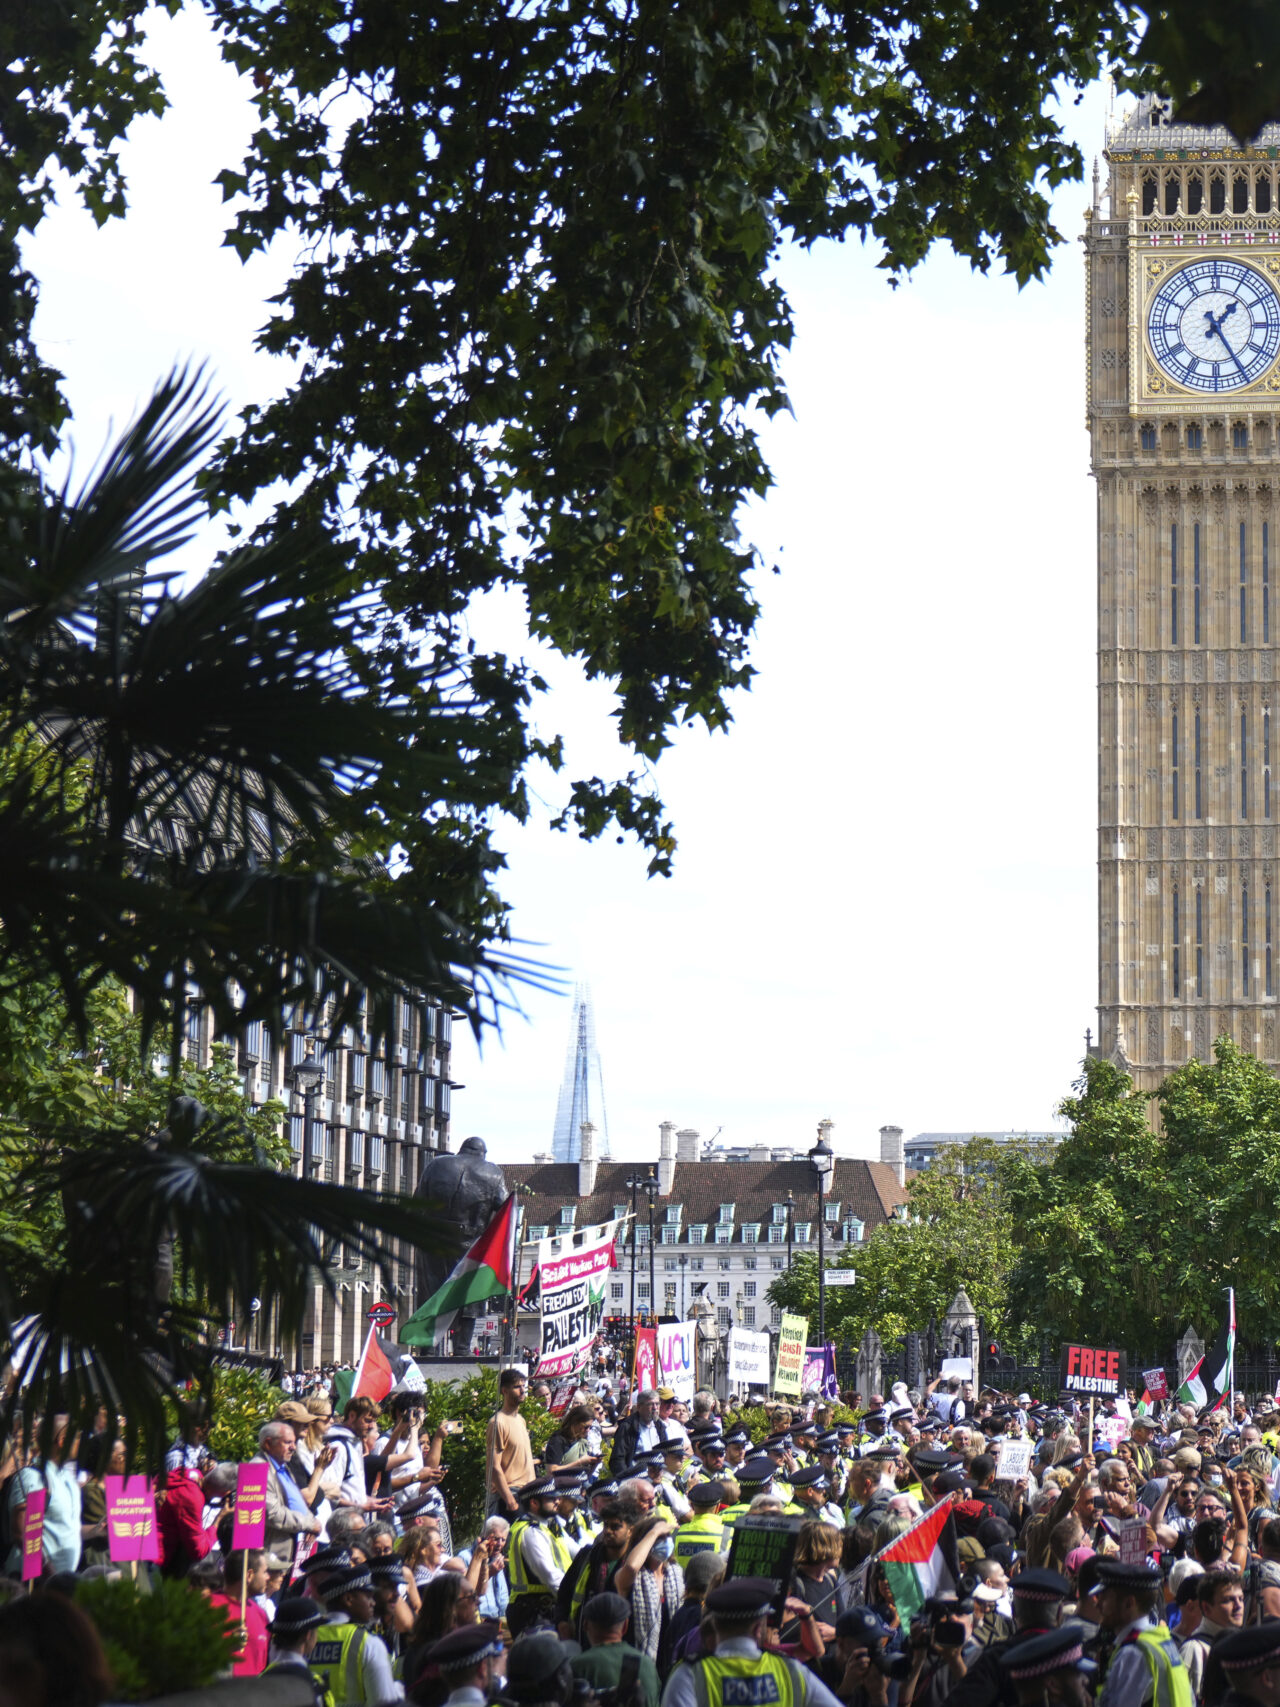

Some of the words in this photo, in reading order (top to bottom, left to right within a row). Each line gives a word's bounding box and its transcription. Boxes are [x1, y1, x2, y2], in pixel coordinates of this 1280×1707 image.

[661, 1332, 690, 1373] UCU
[1067, 1346, 1120, 1380] FREE
[1066, 1375, 1118, 1394] PALESTINE
[110, 1507, 152, 1515] EDUCATION
[739, 1530, 767, 1545] FROM
[768, 1531, 789, 1547] THE
[735, 1545, 764, 1561] RIVER
[766, 1547, 780, 1562] TO
[733, 1560, 751, 1575] THE
[308, 1643, 340, 1662] LICE
